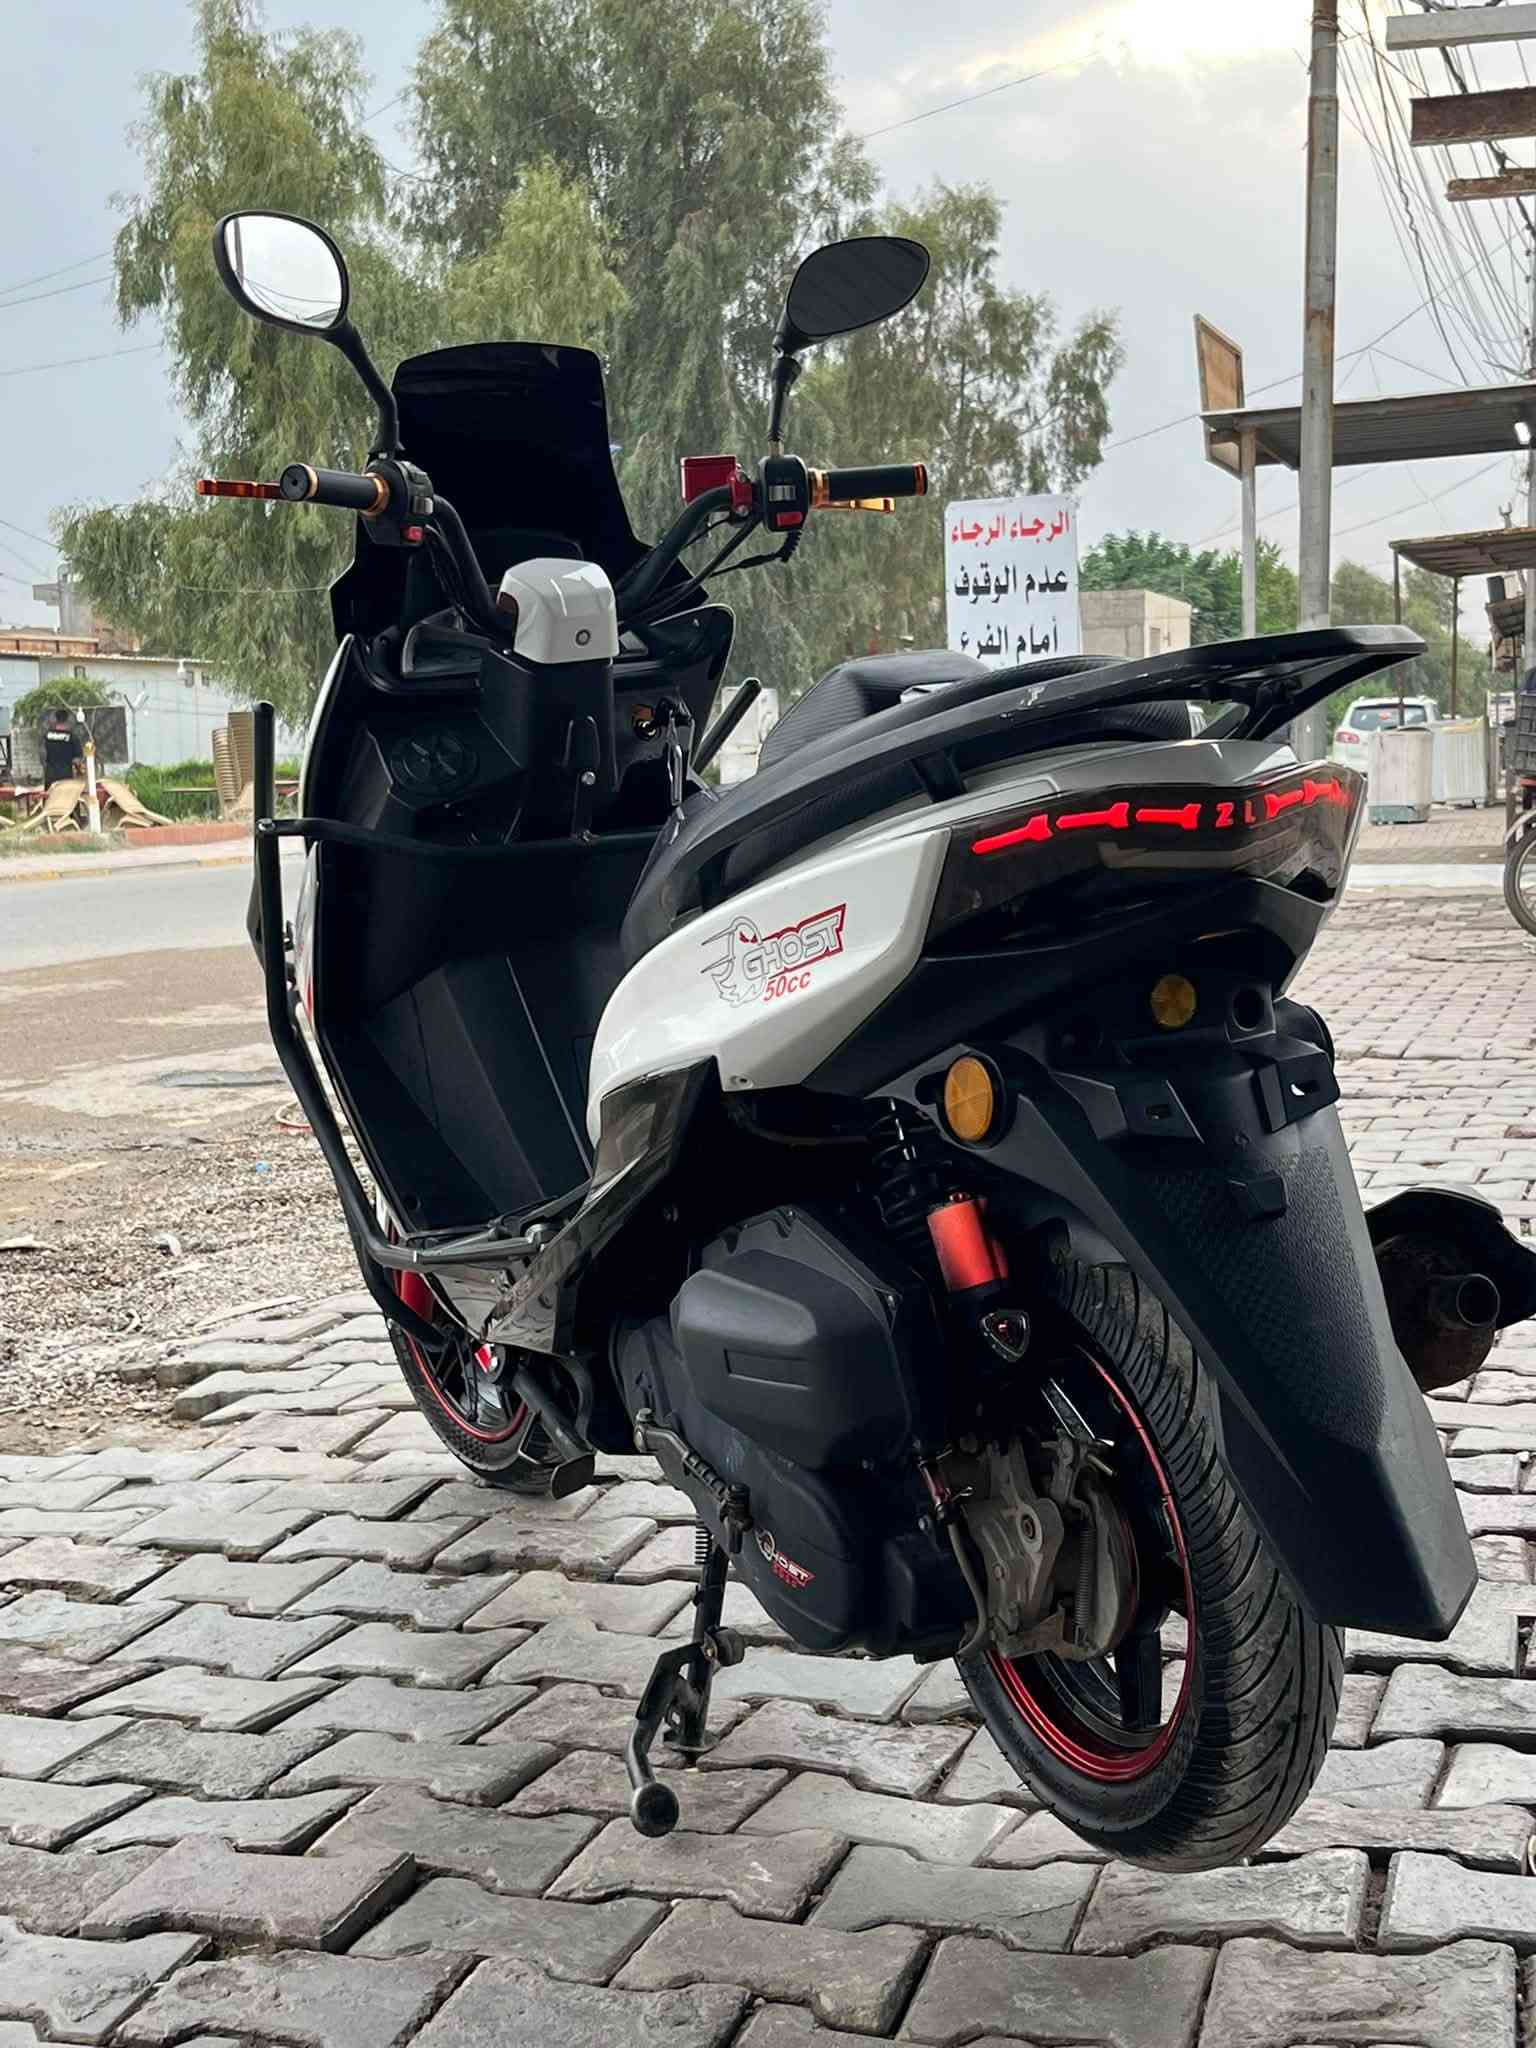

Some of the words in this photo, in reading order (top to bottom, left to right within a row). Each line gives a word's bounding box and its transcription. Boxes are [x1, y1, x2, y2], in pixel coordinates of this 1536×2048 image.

[951, 515, 1006, 547] الرجاء
[1010, 510, 1070, 544] الرجاء
[954, 562, 1017, 604] الوقوف
[1025, 565, 1069, 603] عدم
[1016, 616, 1058, 663] أمام
[743, 914, 840, 981] GHOST
